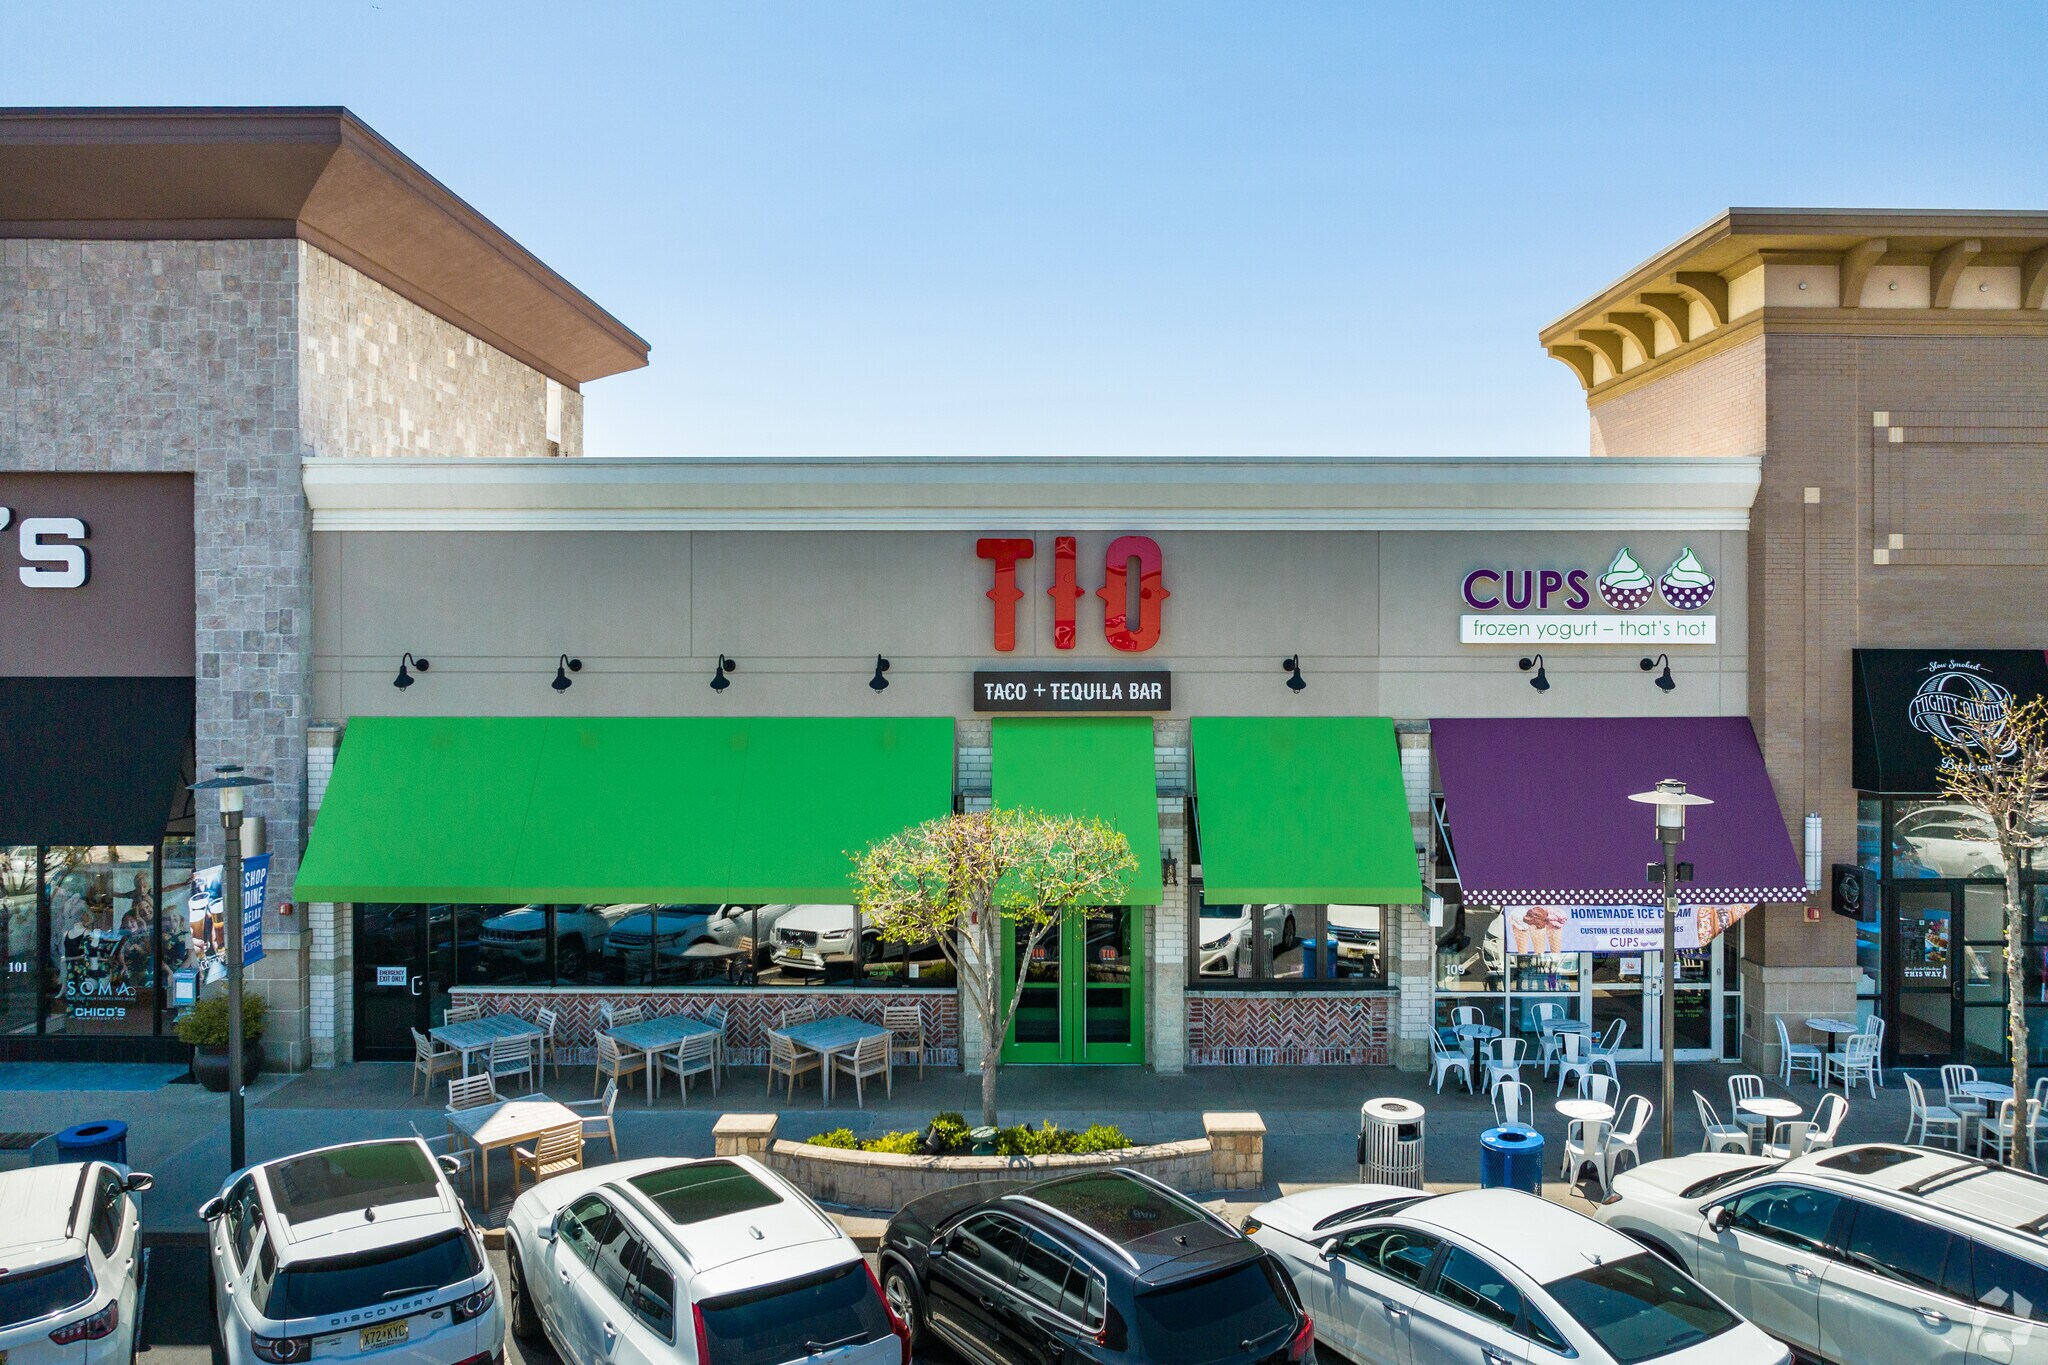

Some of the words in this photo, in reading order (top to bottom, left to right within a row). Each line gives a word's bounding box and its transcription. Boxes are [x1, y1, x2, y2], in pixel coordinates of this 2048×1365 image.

[977, 536, 1170, 652] TIO
[1462, 569, 1590, 610] CUPS
[1473, 620, 1530, 637] frozen
[1536, 621, 1598, 640] yogurt
[1620, 620, 1671, 637] that's
[1676, 620, 1707, 637] hot
[1929, 661, 1947, 672] Slow
[1949, 659, 1981, 671] Smoked
[984, 683, 1027, 700] TACO
[1050, 683, 1122, 701] TEQUILA
[1129, 683, 1162, 700] BAR
[1915, 694, 1959, 715] MIGHTY
[245, 868, 266, 888] SHOP
[245, 886, 264, 909] DINE
[244, 907, 262, 925] RELAX
[1571, 908, 1634, 919] HOMEMADE
[1638, 908, 1654, 919] ICE
[1658, 908, 1691, 919] CAM
[1580, 927, 1608, 935] CUSTOM
[1610, 927, 1620, 935] ICE
[1621, 927, 1645, 935] CREAM
[1610, 937, 1639, 948] CUPS
[1102, 949, 1116, 957] TIO
[8, 962, 28, 973] 101
[1445, 964, 1466, 975] 109
[67, 981, 137, 996] SOMA
[75, 1007, 126, 1017] CHICO'S
[331, 1296, 434, 1326] DISCOVERY
